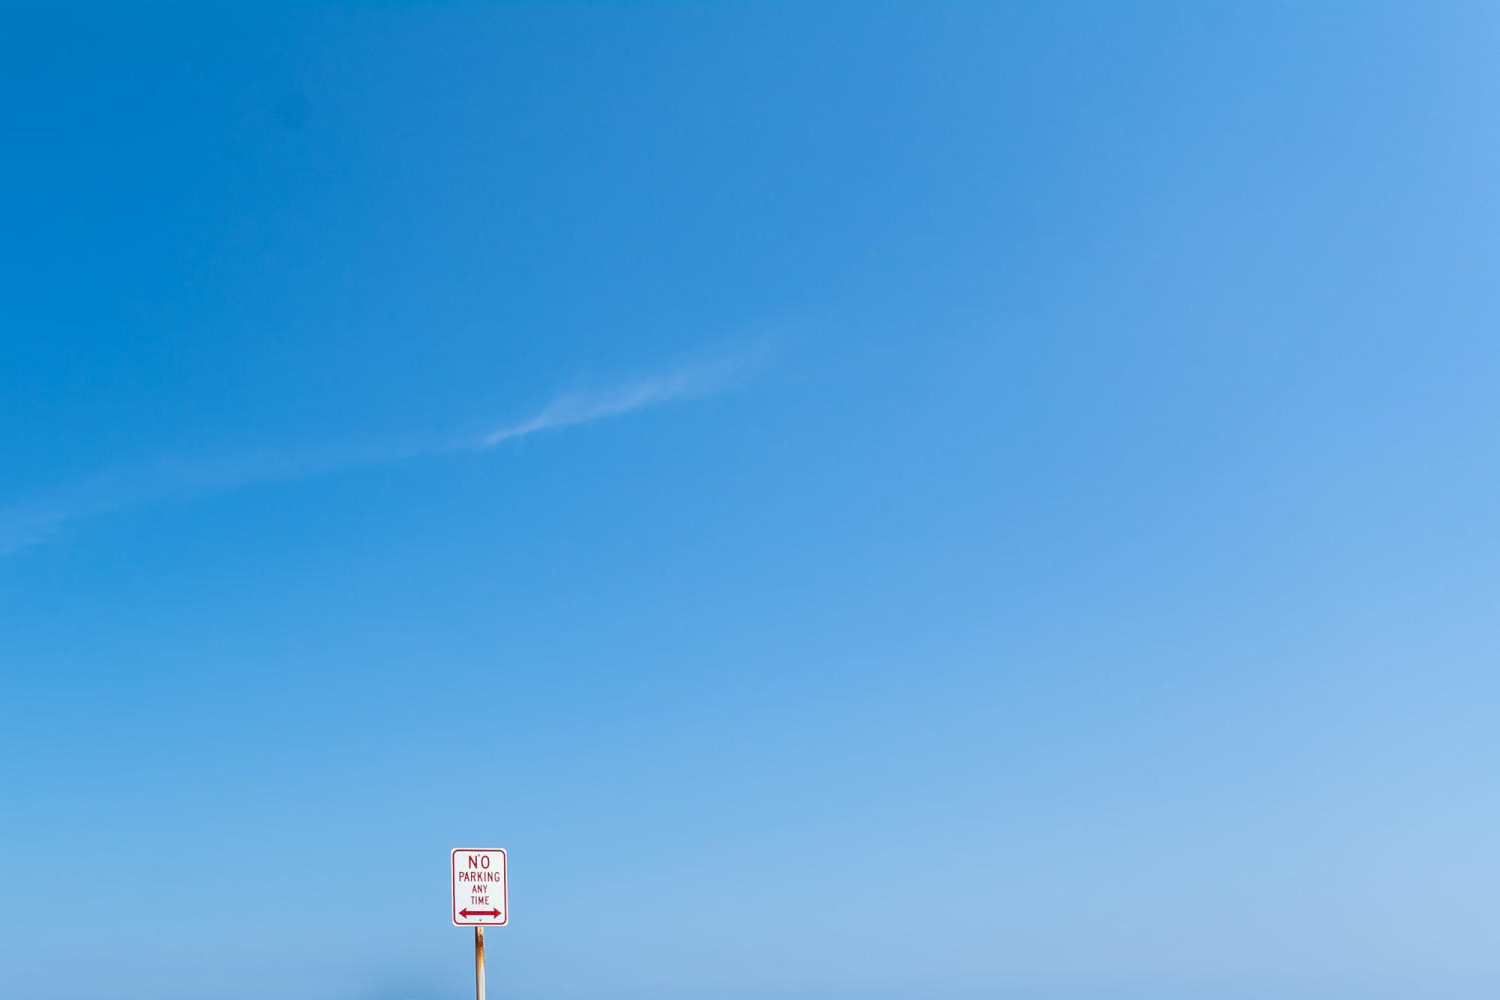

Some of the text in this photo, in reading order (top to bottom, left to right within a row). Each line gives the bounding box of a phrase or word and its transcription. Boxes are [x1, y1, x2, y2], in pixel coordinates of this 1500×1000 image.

[468, 855, 490, 869] NO
[459, 872, 500, 882] PARKING
[472, 884, 488, 893] ANY
[471, 896, 490, 905] TIME
